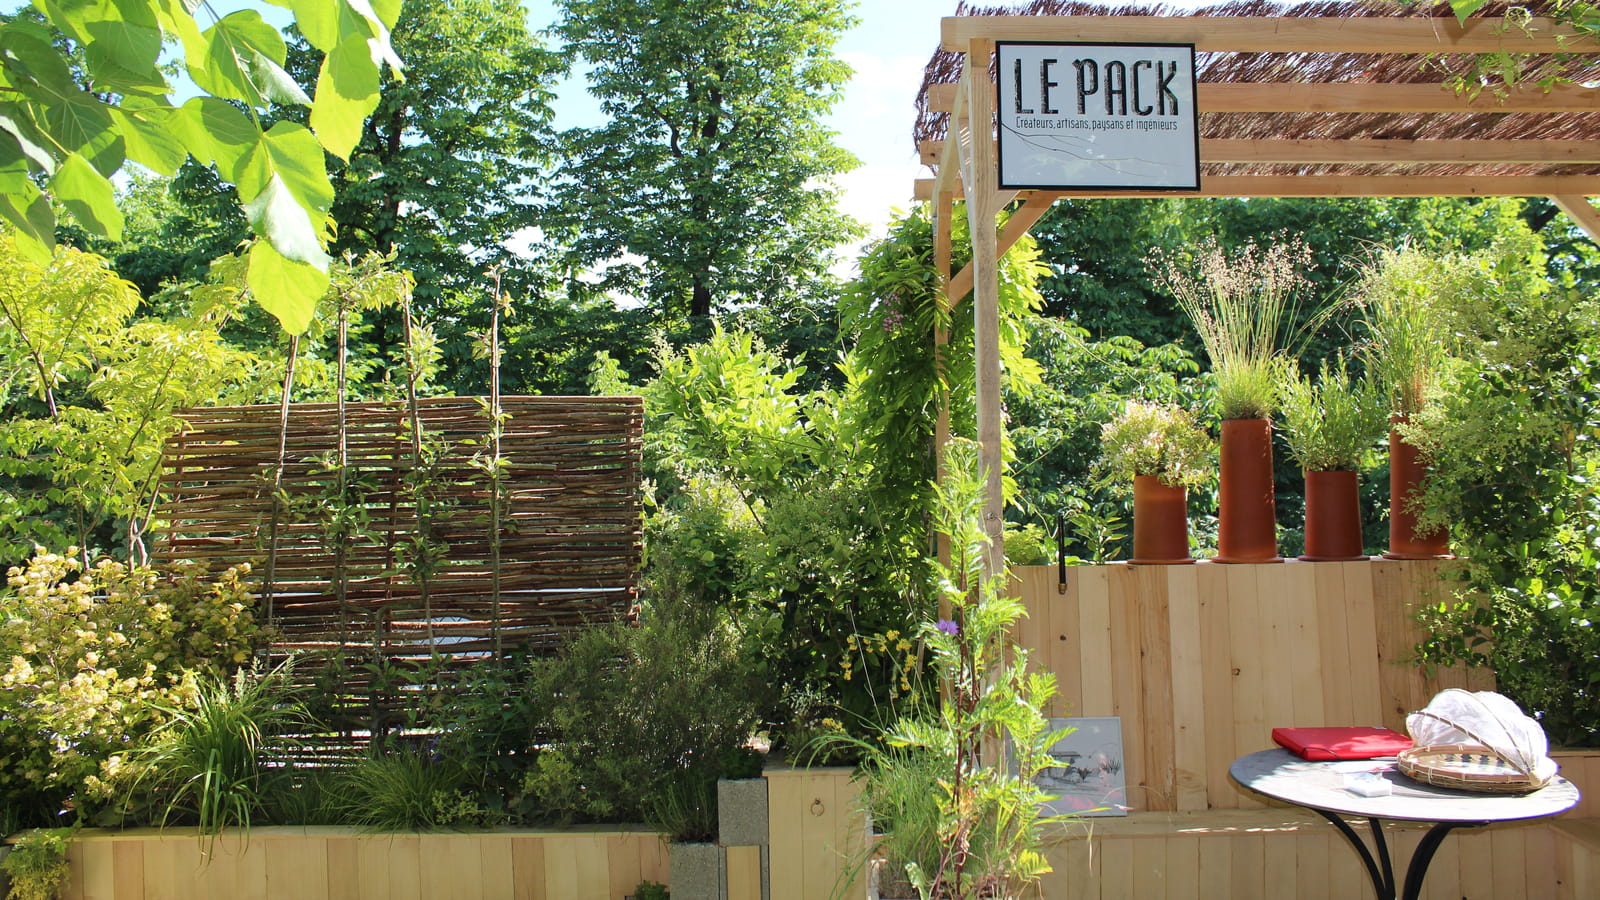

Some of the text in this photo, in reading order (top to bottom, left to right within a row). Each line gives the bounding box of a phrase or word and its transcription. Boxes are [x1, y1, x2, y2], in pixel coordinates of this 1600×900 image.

[1014, 58, 1179, 116] LE PACK
[1056, 118, 1091, 130] artisans,
[1092, 119, 1124, 132] paysans
[1125, 119, 1134, 130] et
